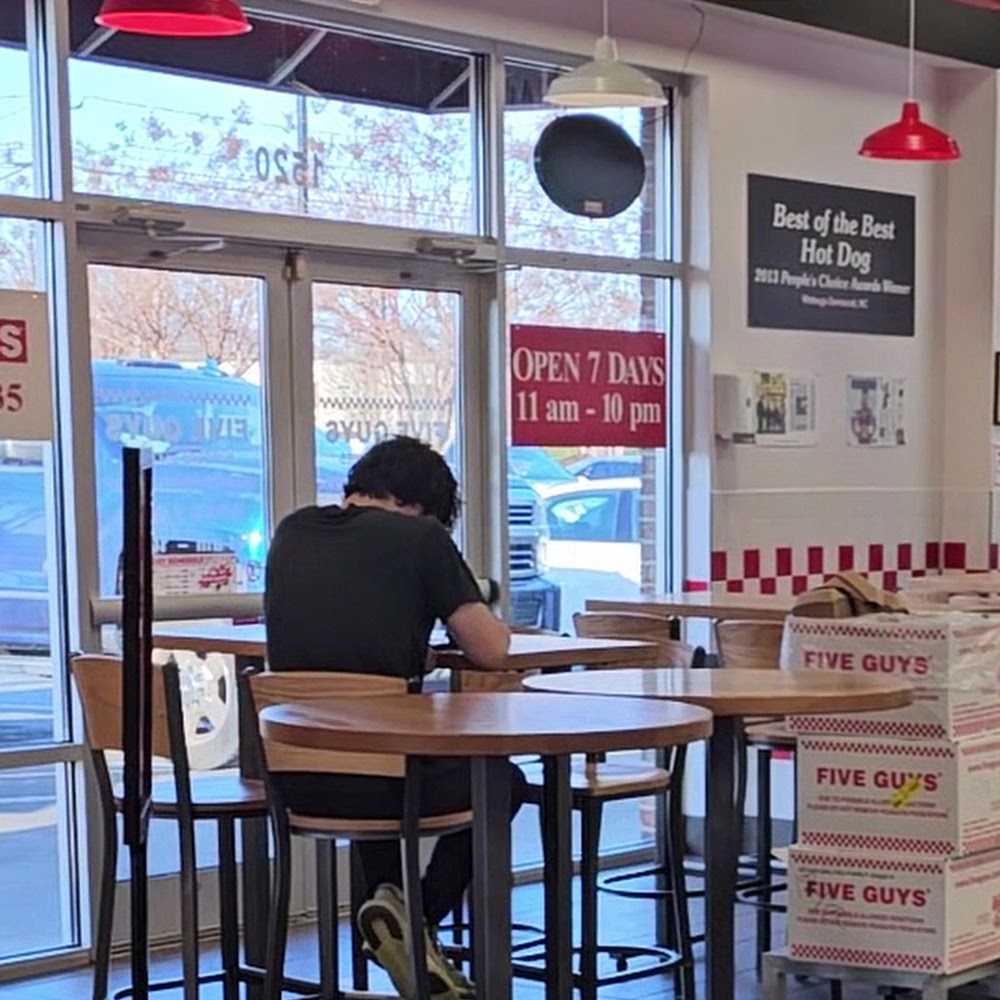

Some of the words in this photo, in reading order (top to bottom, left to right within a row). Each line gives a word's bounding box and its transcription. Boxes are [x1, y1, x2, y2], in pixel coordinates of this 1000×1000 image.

[772, 203, 810, 230] Best
[813, 208, 832, 237] of
[833, 210, 859, 236] the
[861, 213, 896, 240] Best
[800, 237, 834, 265] Hot
[837, 241, 872, 275] Dog
[512, 346, 581, 383] OPEN
[587, 351, 601, 384] 7
[607, 351, 665, 387] DAYS
[516, 390, 539, 422] 11
[545, 398, 580, 423] am
[602, 392, 623, 424] 10
[629, 401, 662, 432] pm
[803, 650, 855, 671] FIVE
[861, 654, 930, 675] GUYS
[816, 767, 866, 787] FIVE
[805, 880, 856, 901] FIVE
[862, 885, 927, 908] GUYS
